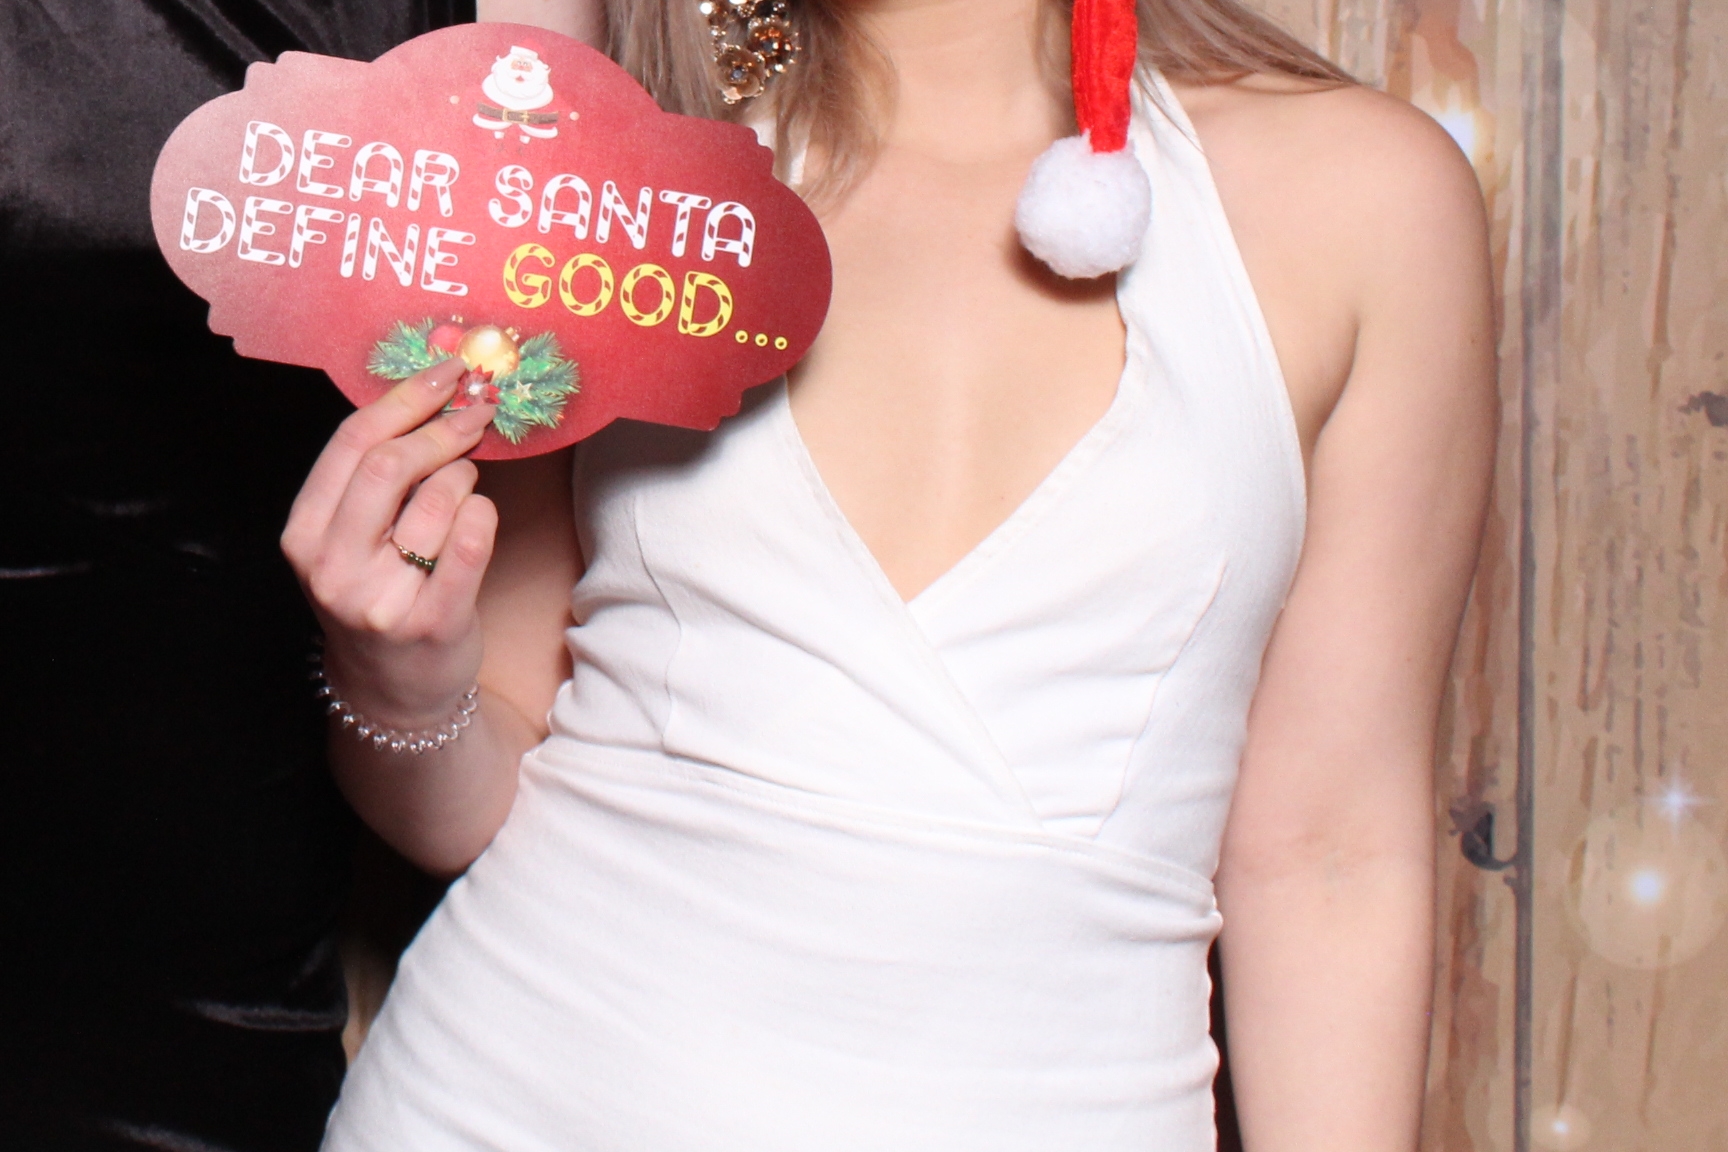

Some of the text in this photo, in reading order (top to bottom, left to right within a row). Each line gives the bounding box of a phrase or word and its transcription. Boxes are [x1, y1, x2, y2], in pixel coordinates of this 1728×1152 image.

[178, 186, 788, 350] DEFINE GOOD...
[238, 119, 757, 268] DEAR SANTA
